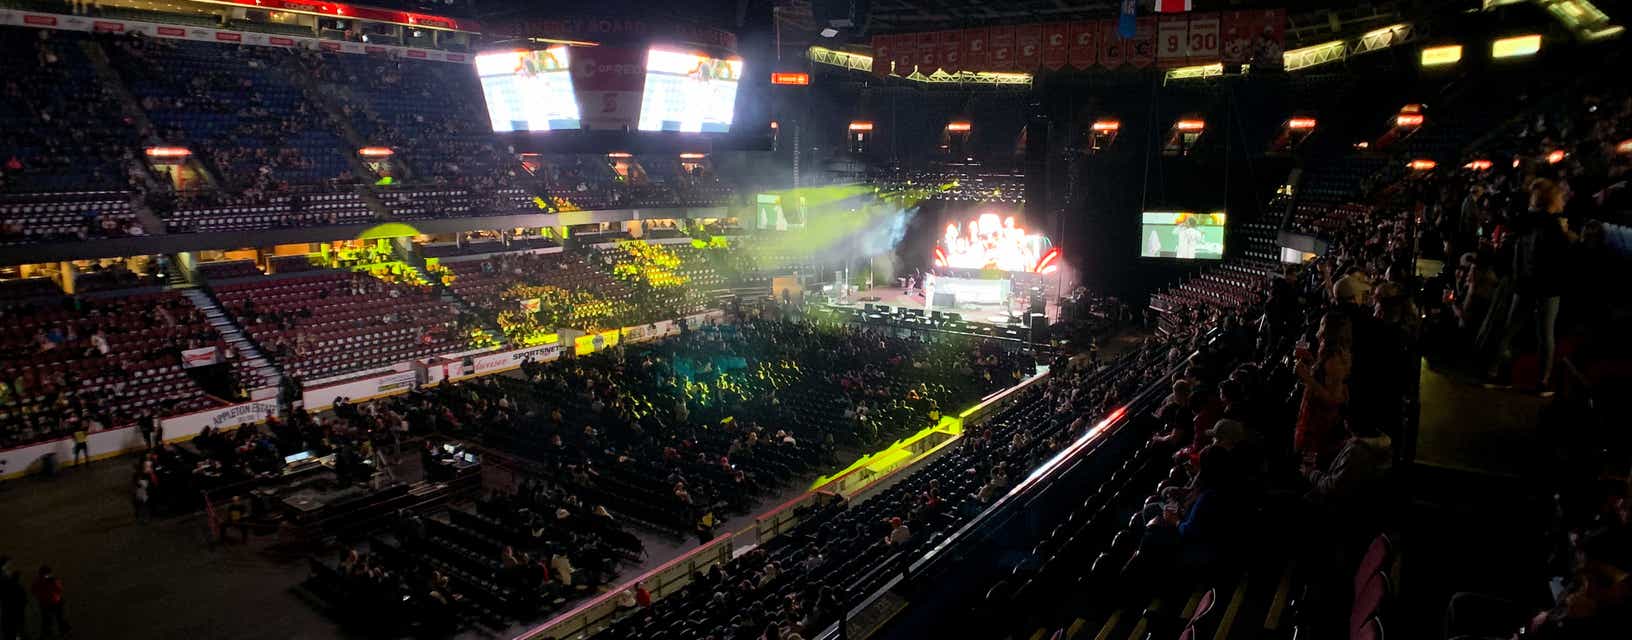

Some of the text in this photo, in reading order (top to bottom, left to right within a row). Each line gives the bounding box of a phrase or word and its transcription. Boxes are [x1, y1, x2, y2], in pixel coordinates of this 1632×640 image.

[1167, 35, 1178, 53] 9
[1191, 33, 1216, 51] 30
[512, 345, 559, 359] SPORTSNET
[213, 406, 251, 424] APPLETON
